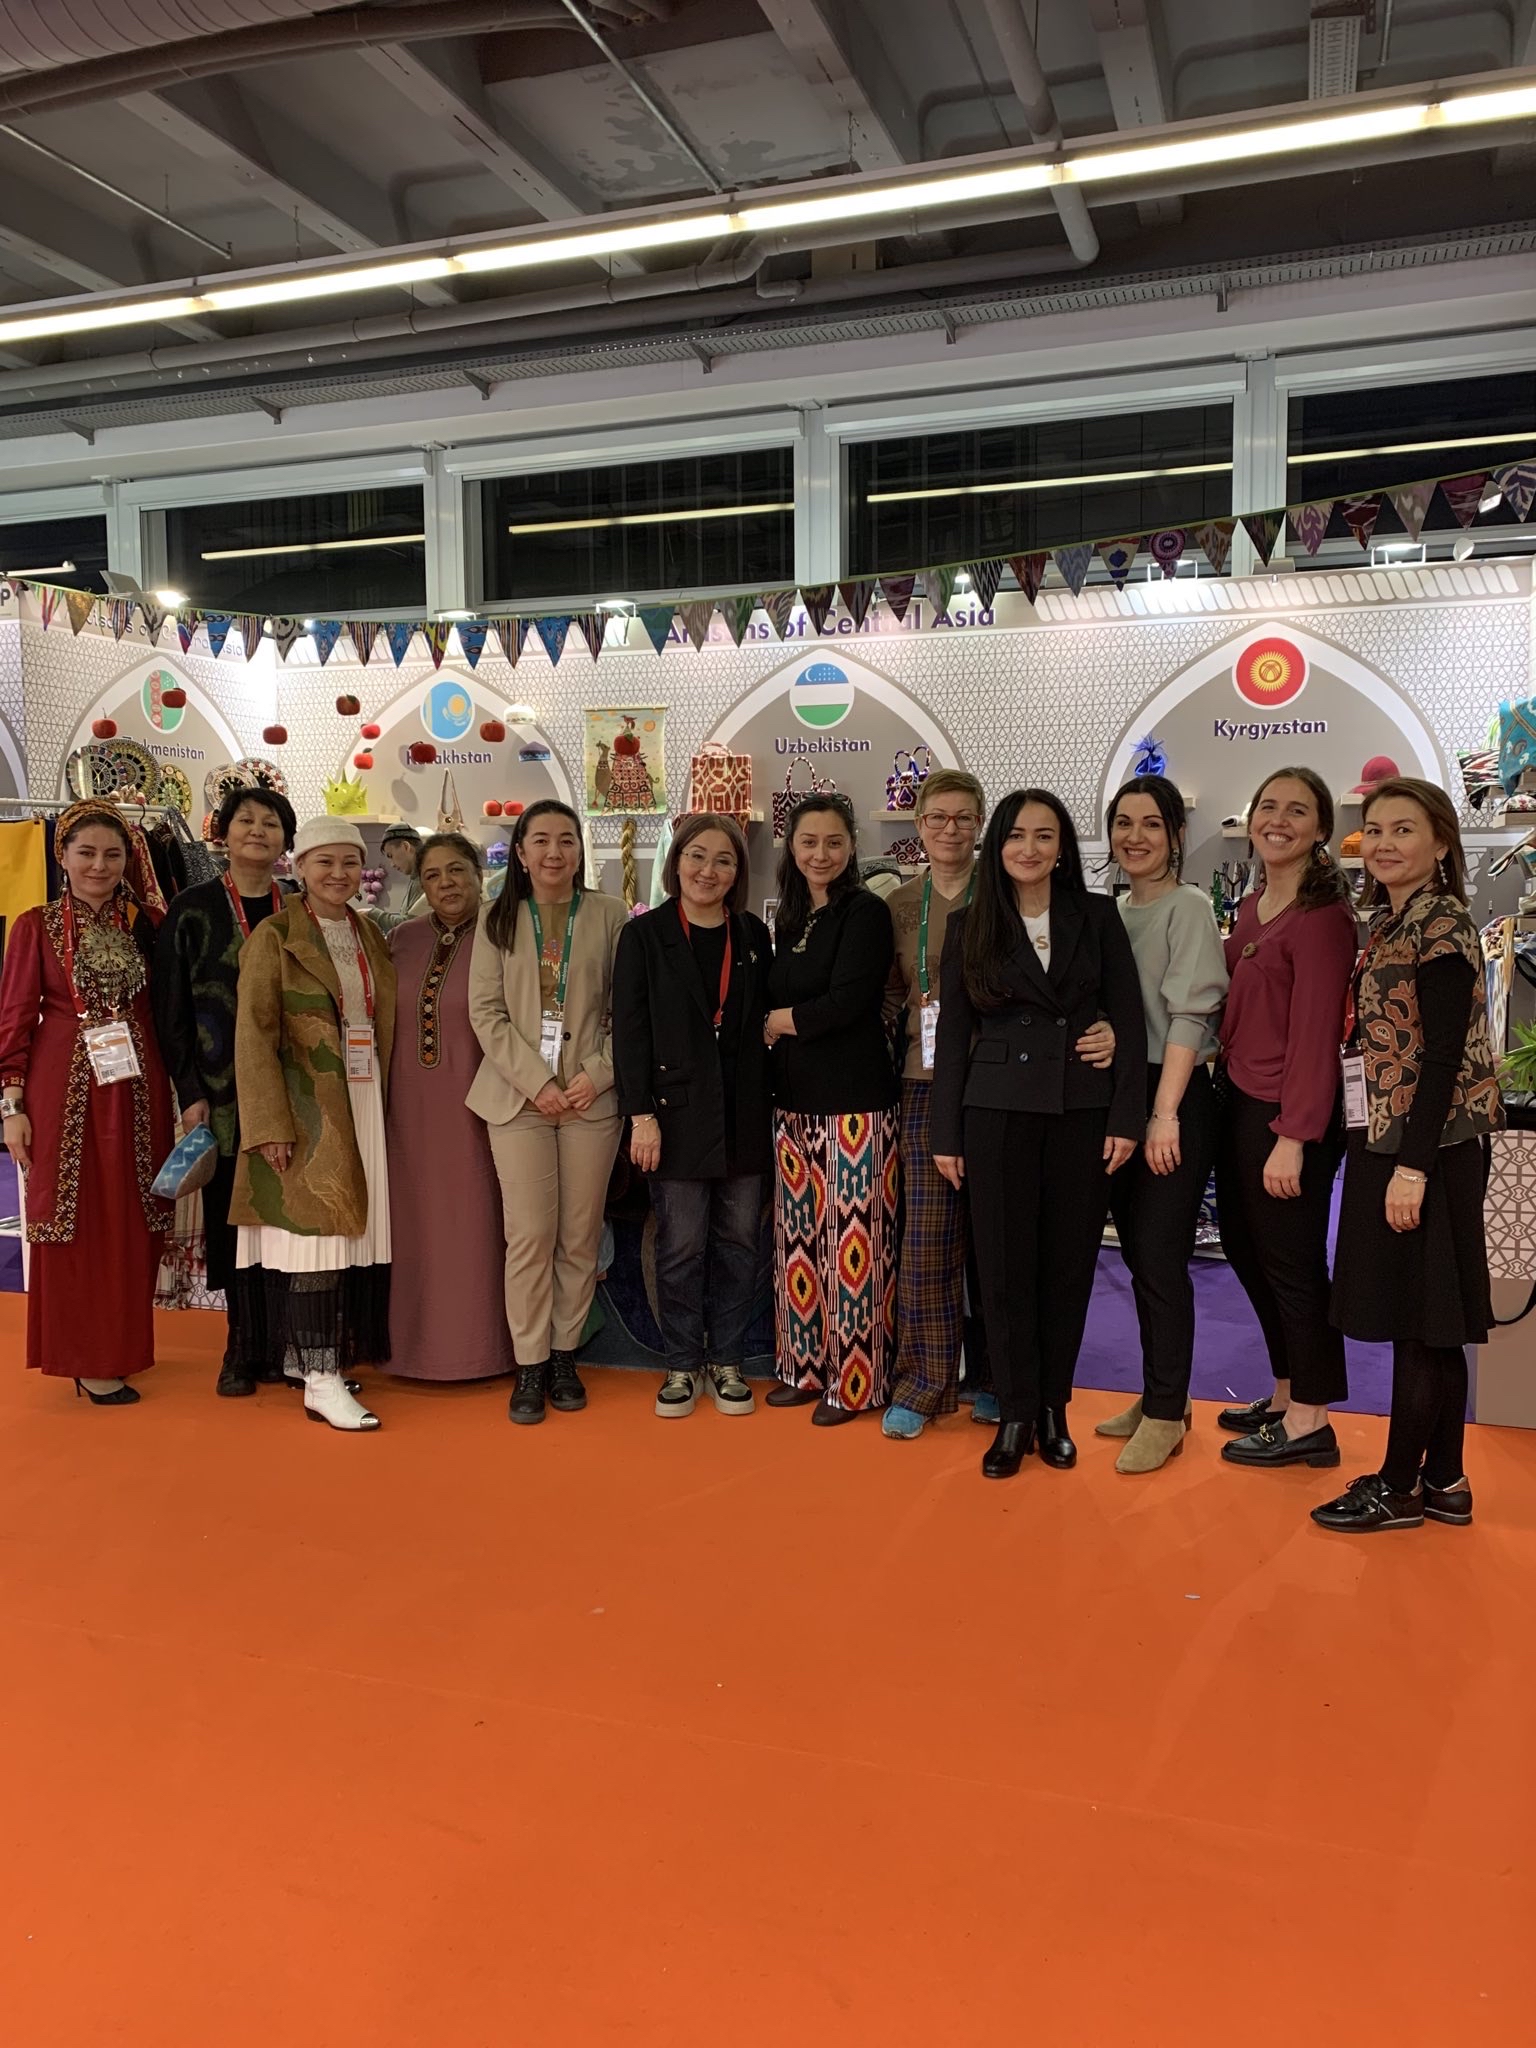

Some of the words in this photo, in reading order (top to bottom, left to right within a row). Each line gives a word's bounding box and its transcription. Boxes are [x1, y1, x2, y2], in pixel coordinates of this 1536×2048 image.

[930, 601, 995, 629] Asia
[222, 640, 243, 656] sia
[1214, 719, 1327, 741] Kyrgyzstan
[775, 737, 871, 754] Uzbekistan
[406, 749, 493, 765] Kakhstan
